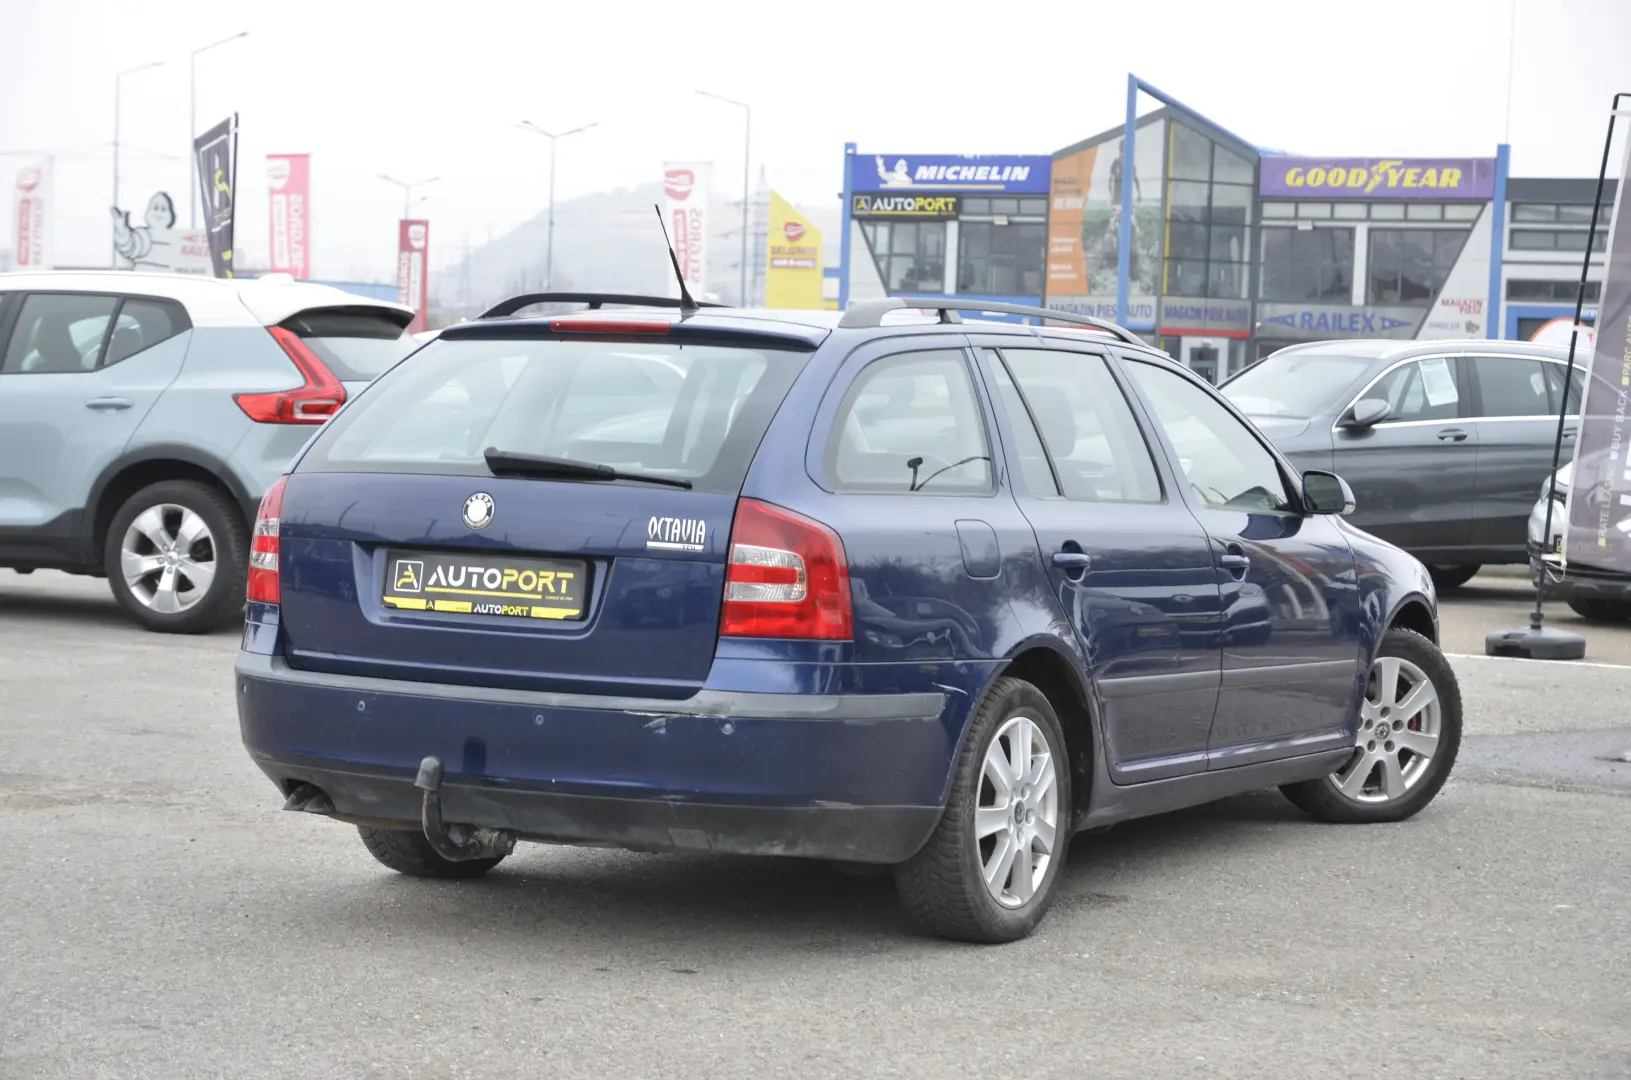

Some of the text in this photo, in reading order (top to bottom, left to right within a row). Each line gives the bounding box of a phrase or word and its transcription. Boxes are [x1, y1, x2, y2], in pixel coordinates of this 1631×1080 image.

[914, 165, 1031, 182] MICHELIN
[1285, 166, 1462, 189] GOODYEAR
[872, 197, 957, 211] AUTOPORT
[1096, 303, 1117, 318] PIES
[1300, 310, 1376, 333] RAILEX
[1622, 346, 1631, 377] PARC
[1616, 389, 1628, 424] BACK
[1611, 424, 1623, 451] BUY
[648, 516, 706, 544] OCTAVIA
[1598, 509, 1610, 538] RATE
[427, 564, 574, 594] AUTOPORT
[473, 603, 530, 617] AUTOPORT
